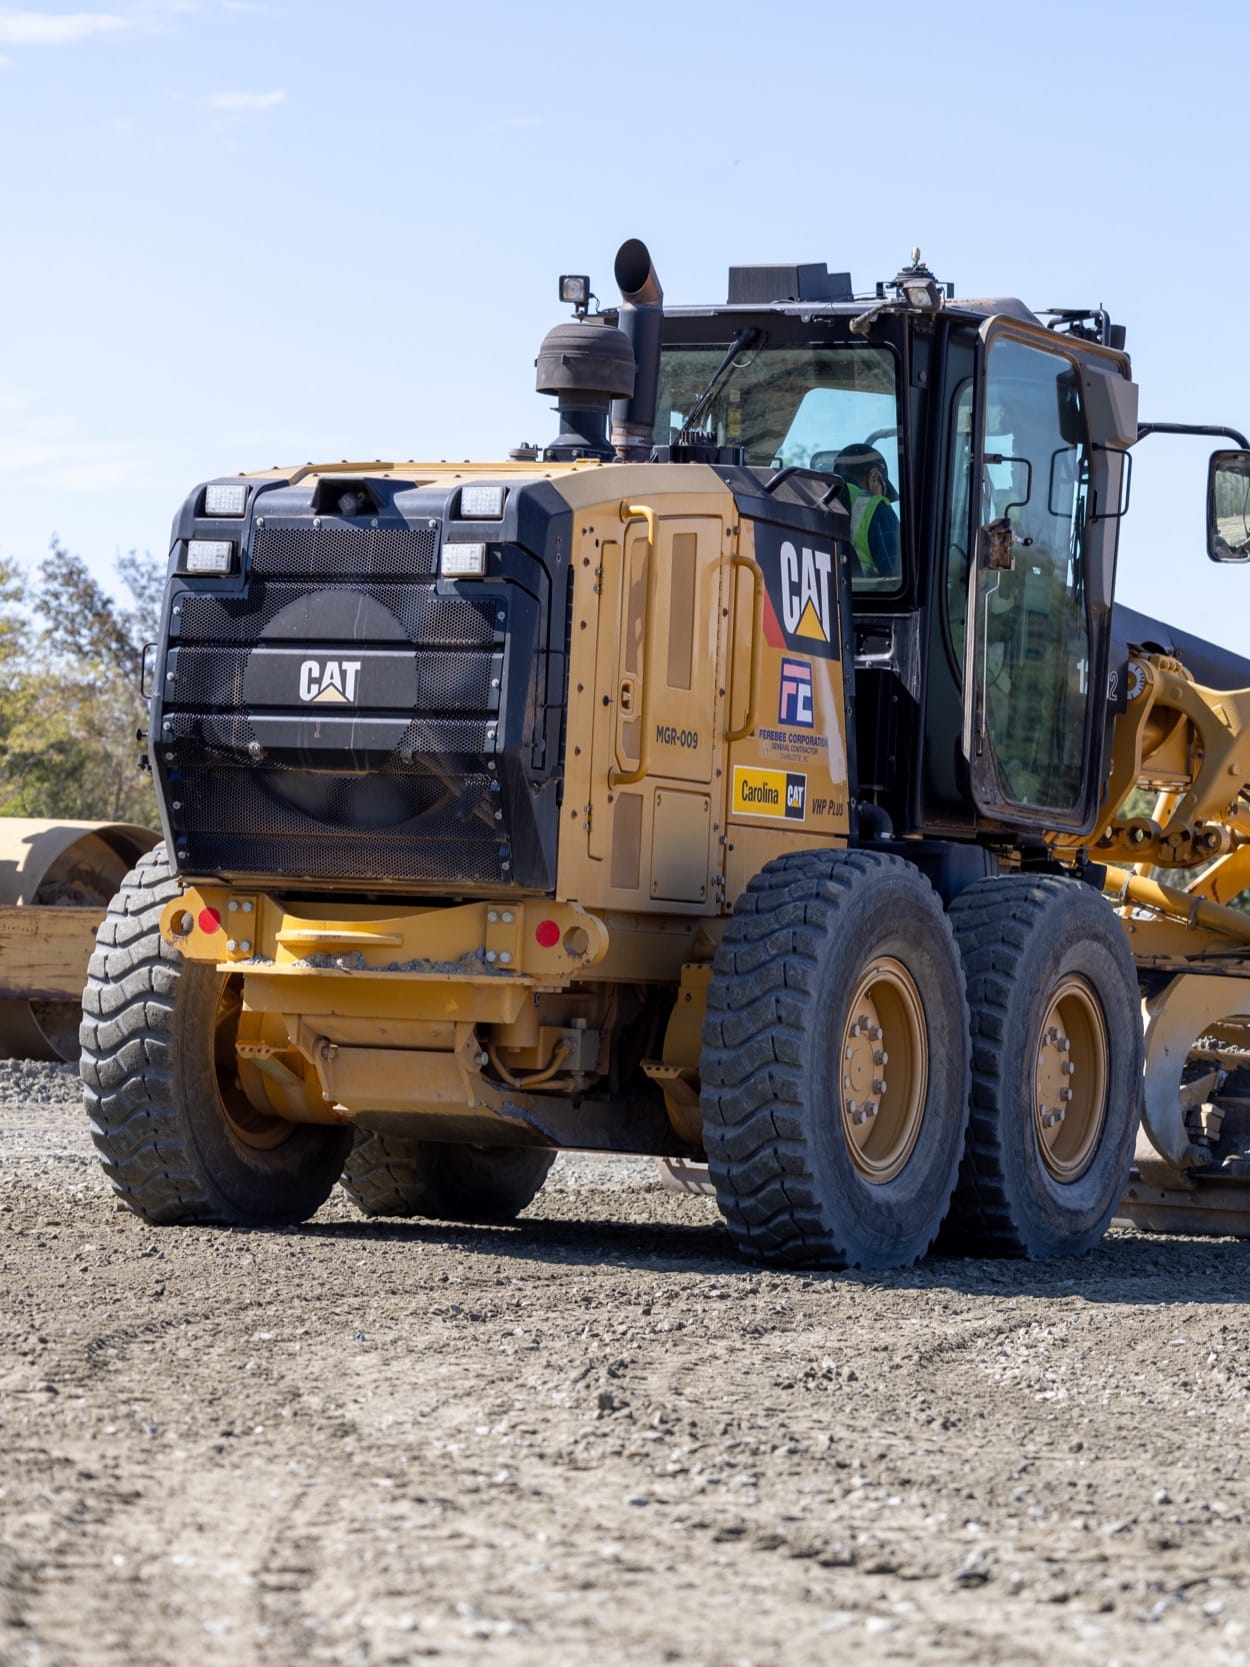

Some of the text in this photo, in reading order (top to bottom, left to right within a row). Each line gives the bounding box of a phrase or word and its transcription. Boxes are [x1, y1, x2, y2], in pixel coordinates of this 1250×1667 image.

[780, 541, 831, 643] CAT
[299, 660, 361, 702] CAT
[656, 724, 698, 749] MGR-009
[759, 729, 787, 742] FEREBEE
[741, 780, 804, 808] Carolina CAT
[812, 798, 844, 816] VHP PLUS
